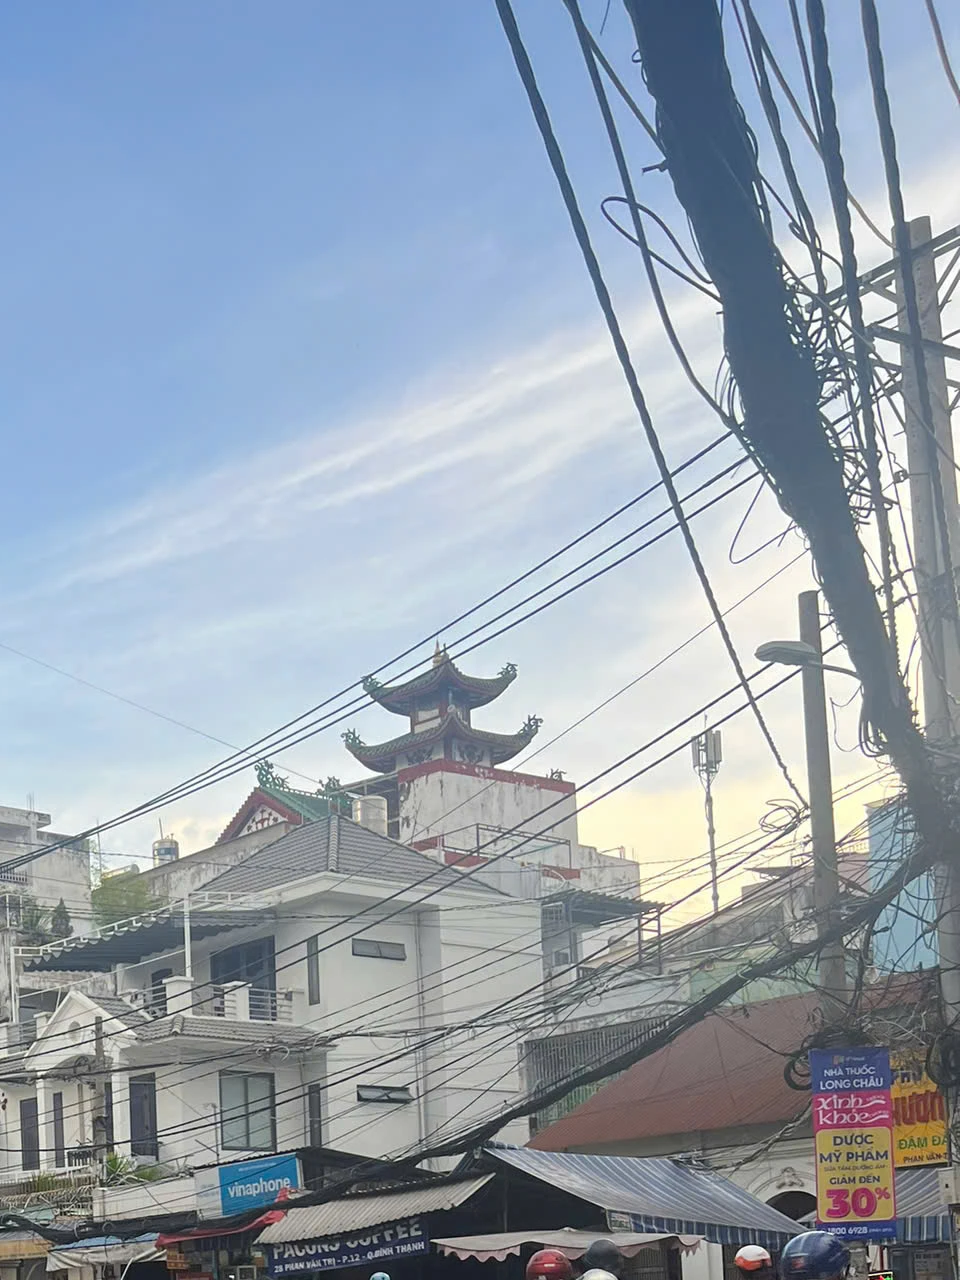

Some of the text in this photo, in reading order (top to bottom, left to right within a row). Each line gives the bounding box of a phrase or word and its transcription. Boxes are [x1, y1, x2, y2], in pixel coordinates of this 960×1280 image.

[824, 1064, 876, 1077] NHÀ THUỐC
[820, 1080, 851, 1090] LONG
[853, 1076, 883, 1088] CHÂU
[833, 1133, 874, 1148] DƯỢC
[829, 1174, 856, 1185] GIẢM
[228, 1177, 291, 1198] vinaphone
[825, 1187, 890, 1218] 30%
[285, 1260, 305, 1271] PHAN
